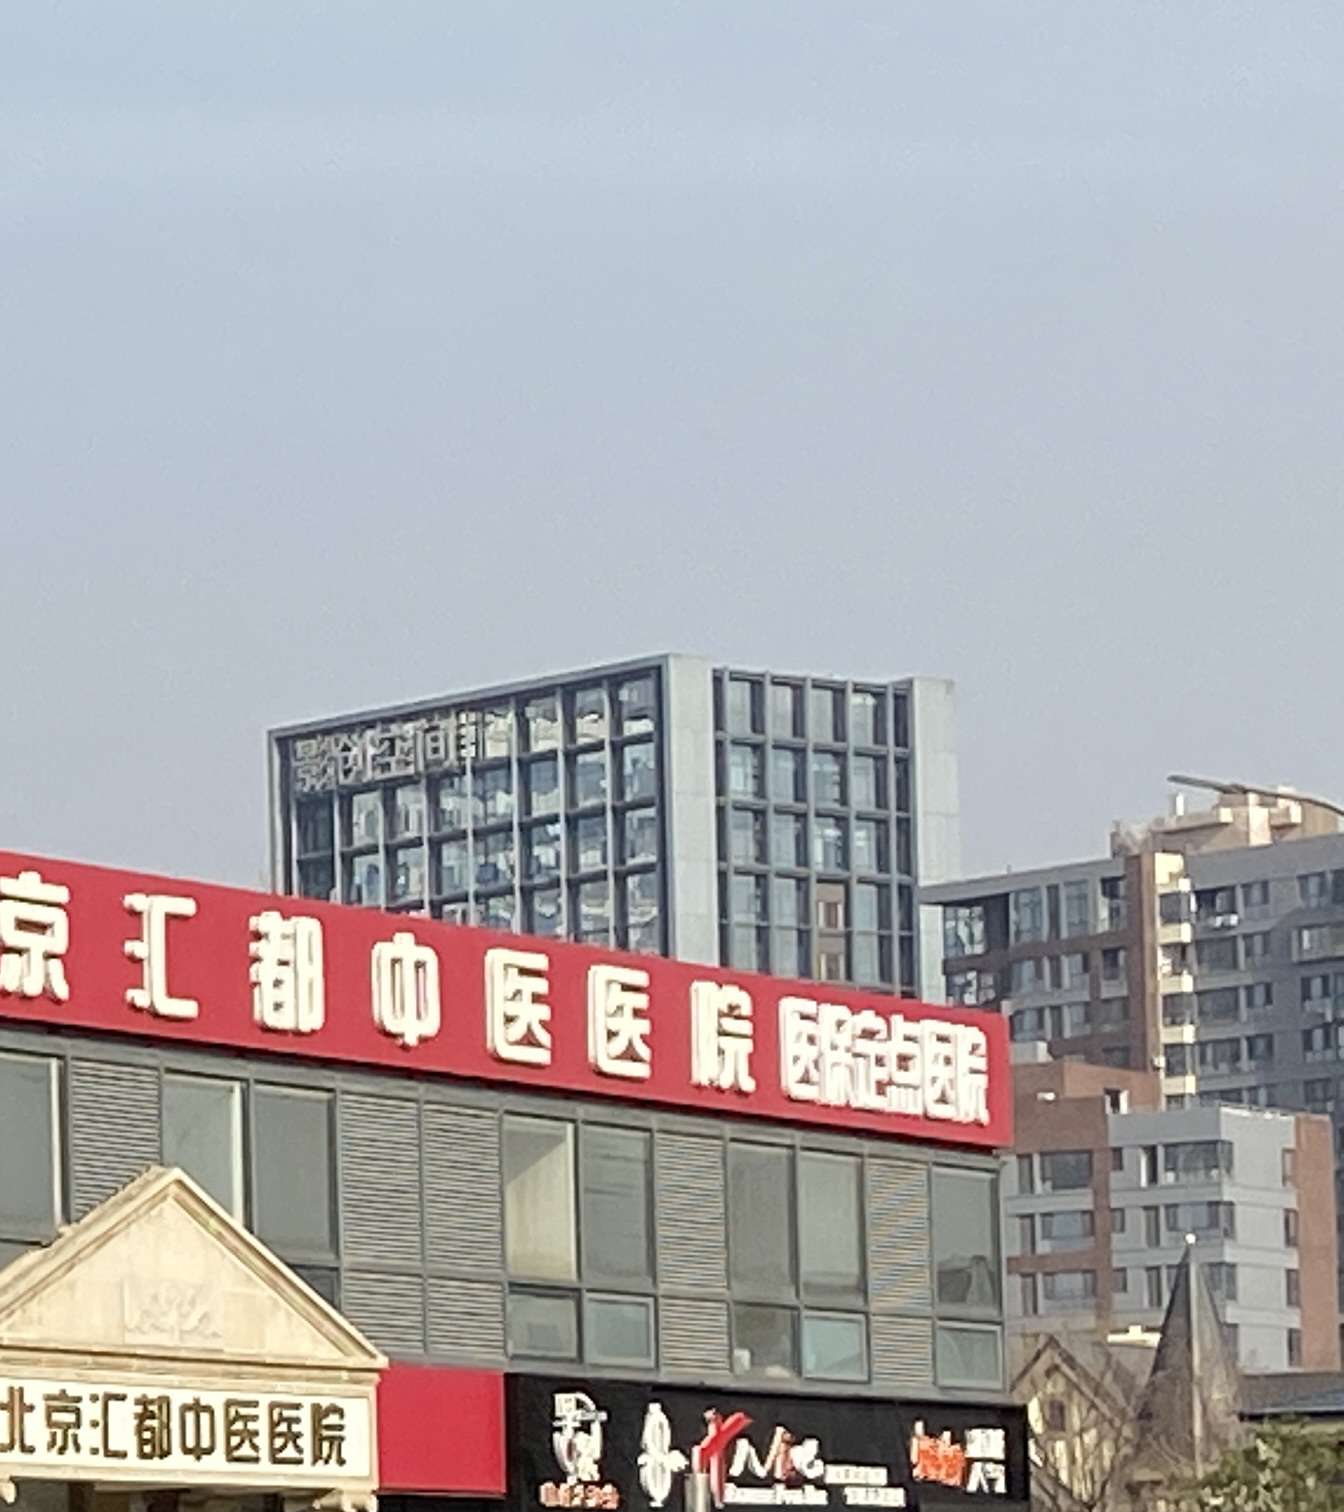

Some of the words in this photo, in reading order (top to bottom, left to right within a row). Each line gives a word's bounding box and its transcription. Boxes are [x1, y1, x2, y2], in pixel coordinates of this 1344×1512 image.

[779, 995, 991, 1125] 医保定点医院
